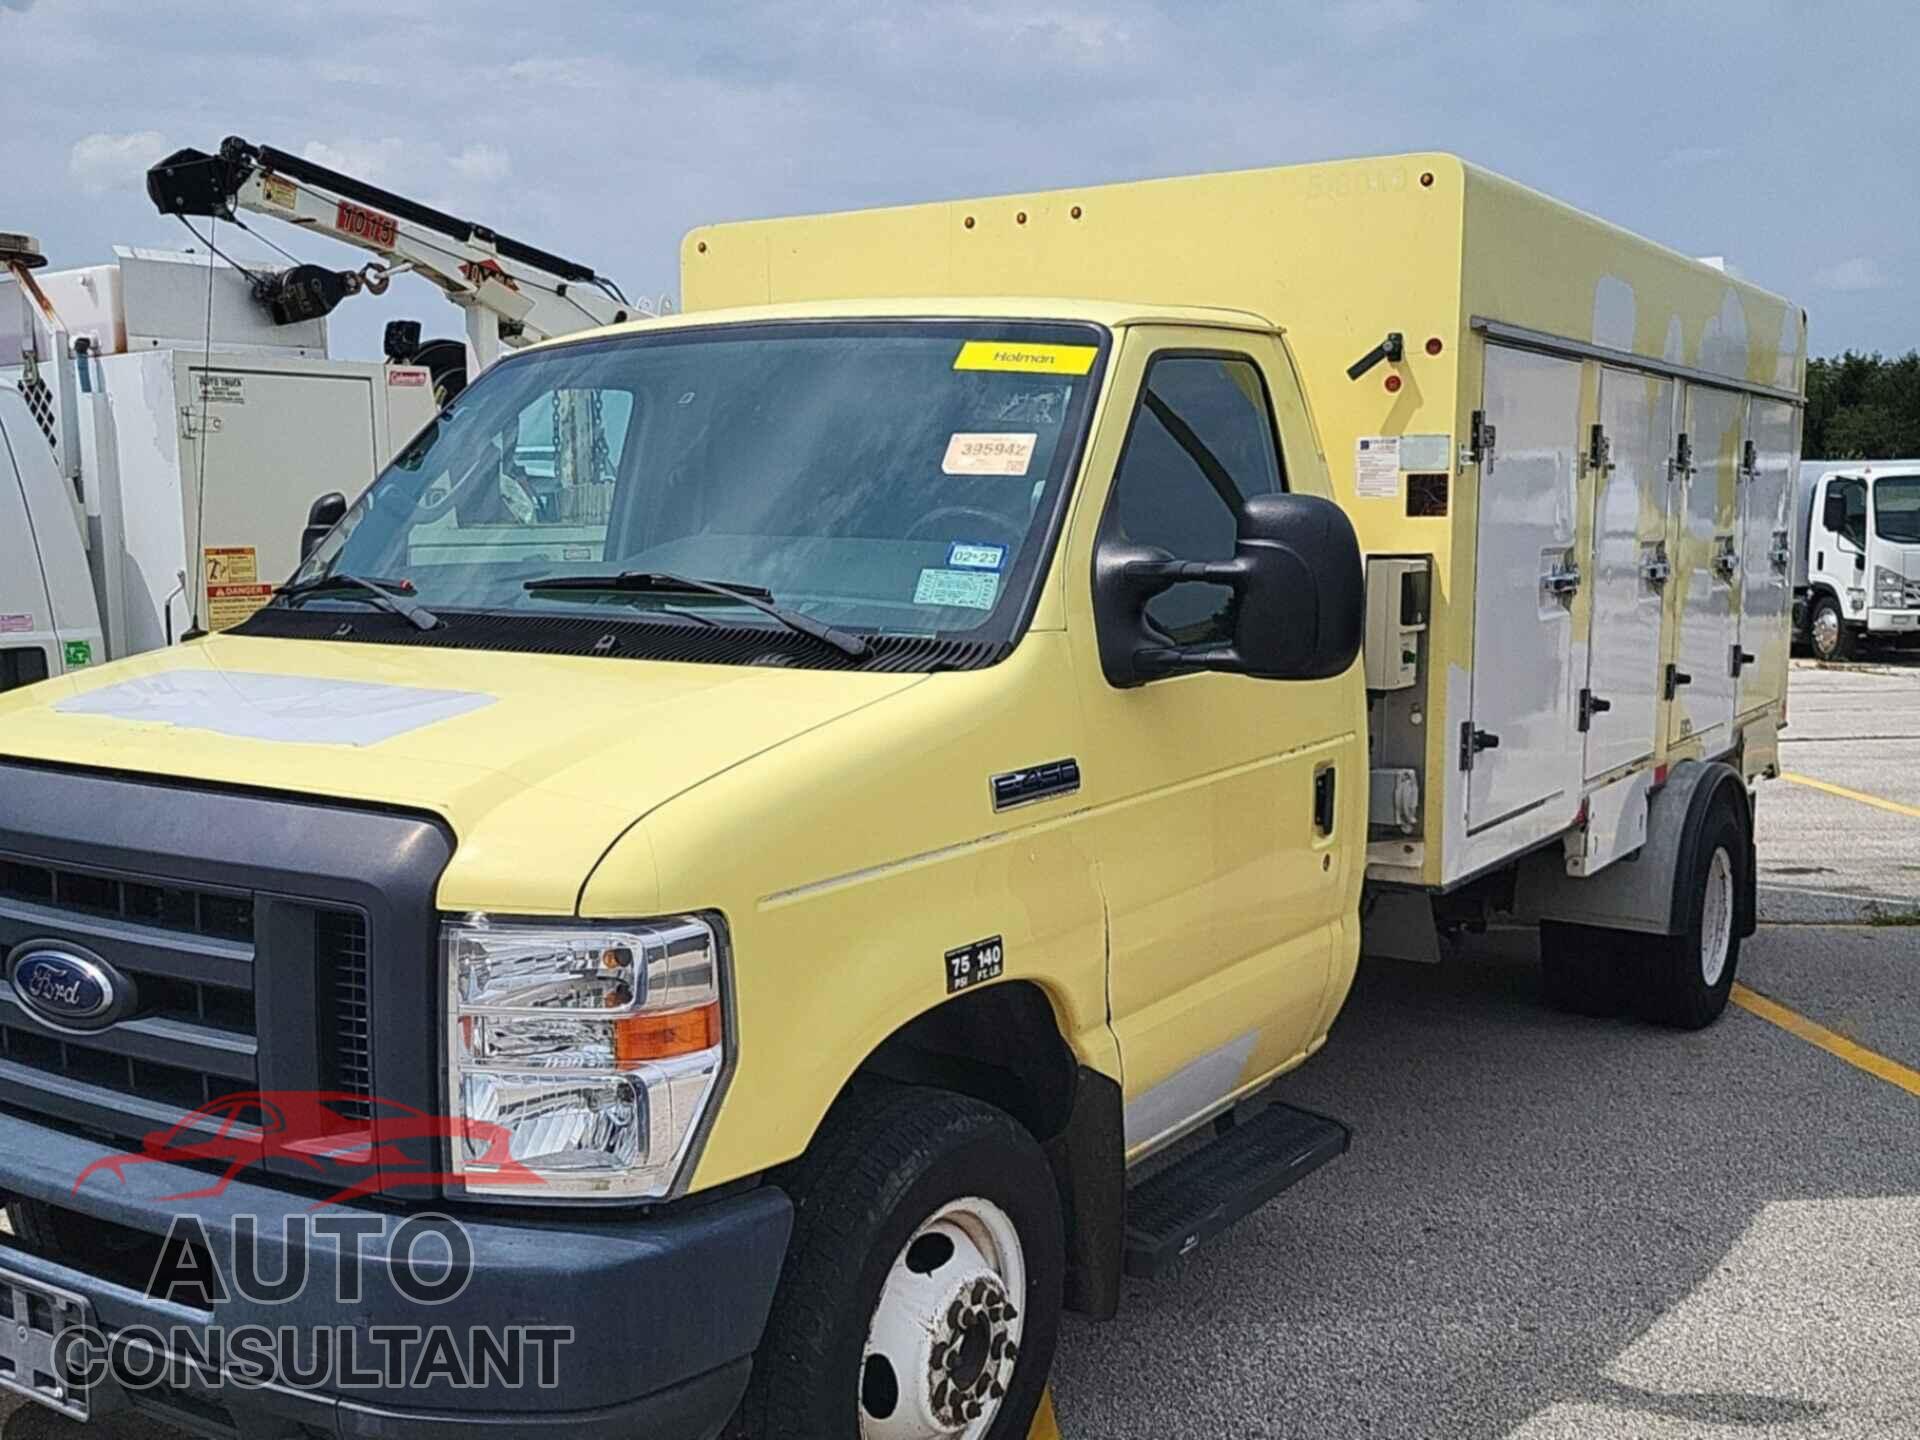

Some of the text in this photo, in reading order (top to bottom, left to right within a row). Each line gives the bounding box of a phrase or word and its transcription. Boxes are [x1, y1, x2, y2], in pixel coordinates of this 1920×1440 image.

[994, 352, 1055, 363] Holman
[951, 955, 970, 976] 75
[977, 945, 1001, 968] 140
[30, 963, 80, 1004] Ford
